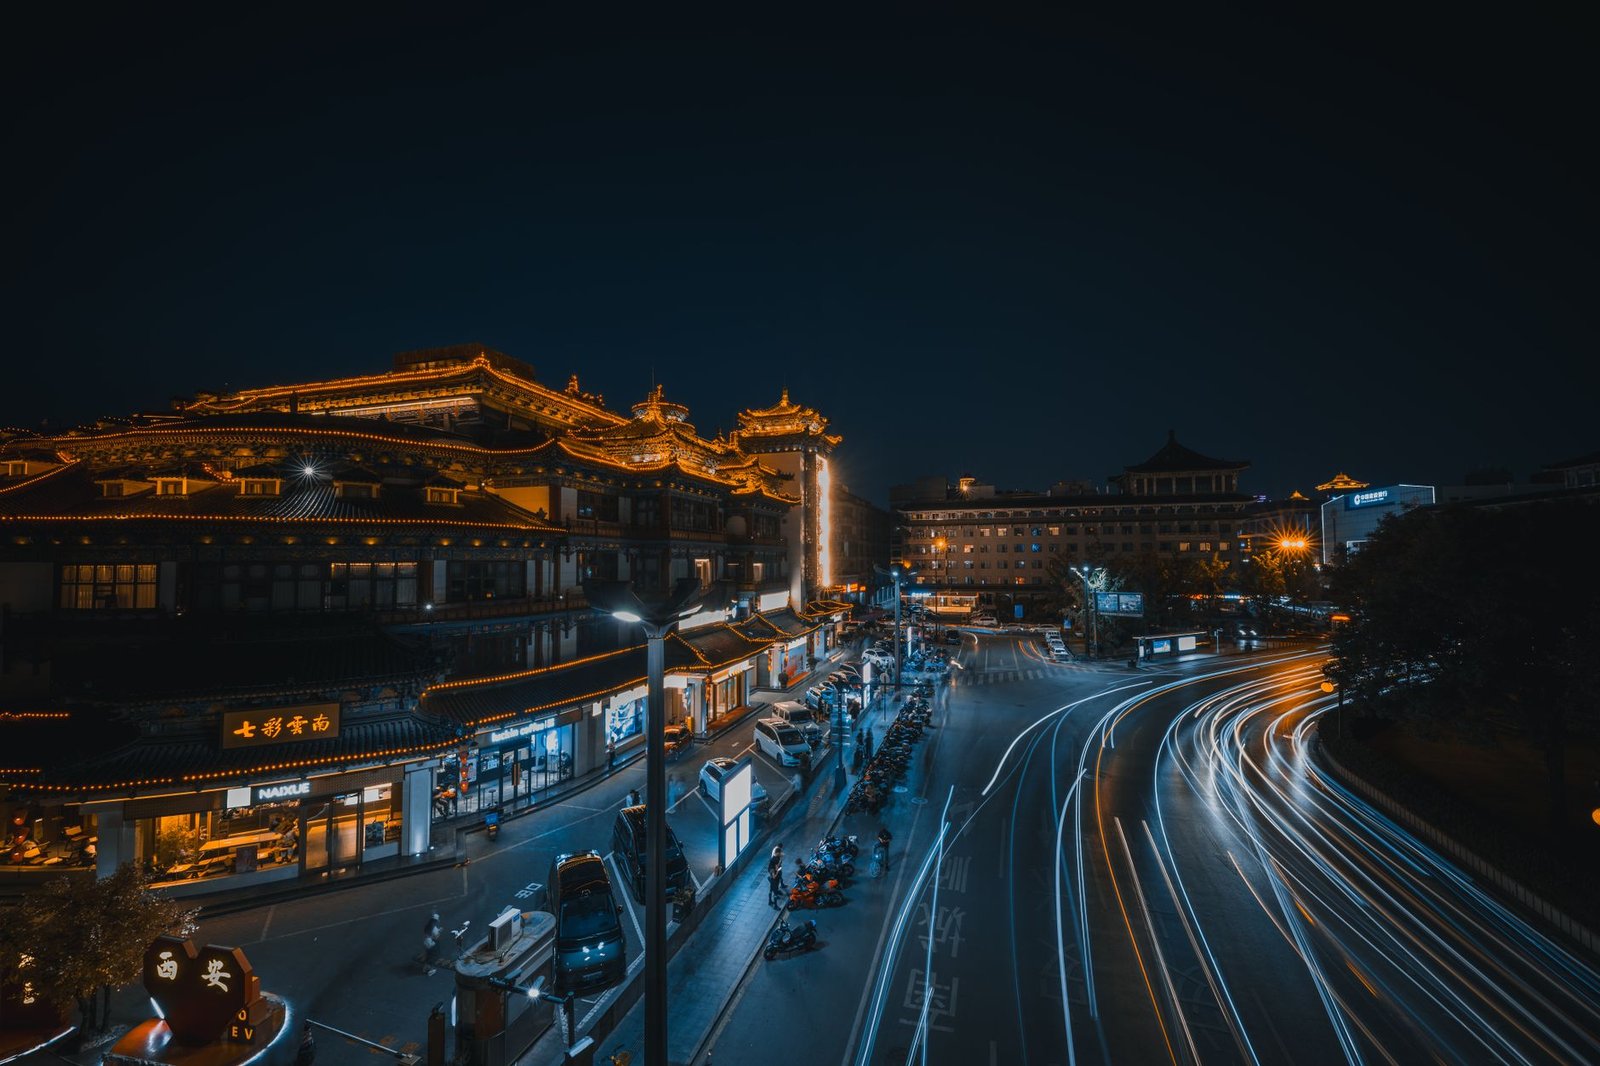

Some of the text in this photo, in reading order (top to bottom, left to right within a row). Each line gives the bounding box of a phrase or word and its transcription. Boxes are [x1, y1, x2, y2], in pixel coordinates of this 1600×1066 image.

[233, 714, 330, 738] 七彩雲南
[259, 782, 310, 800] NAIXUE
[156, 951, 232, 992] 西安
